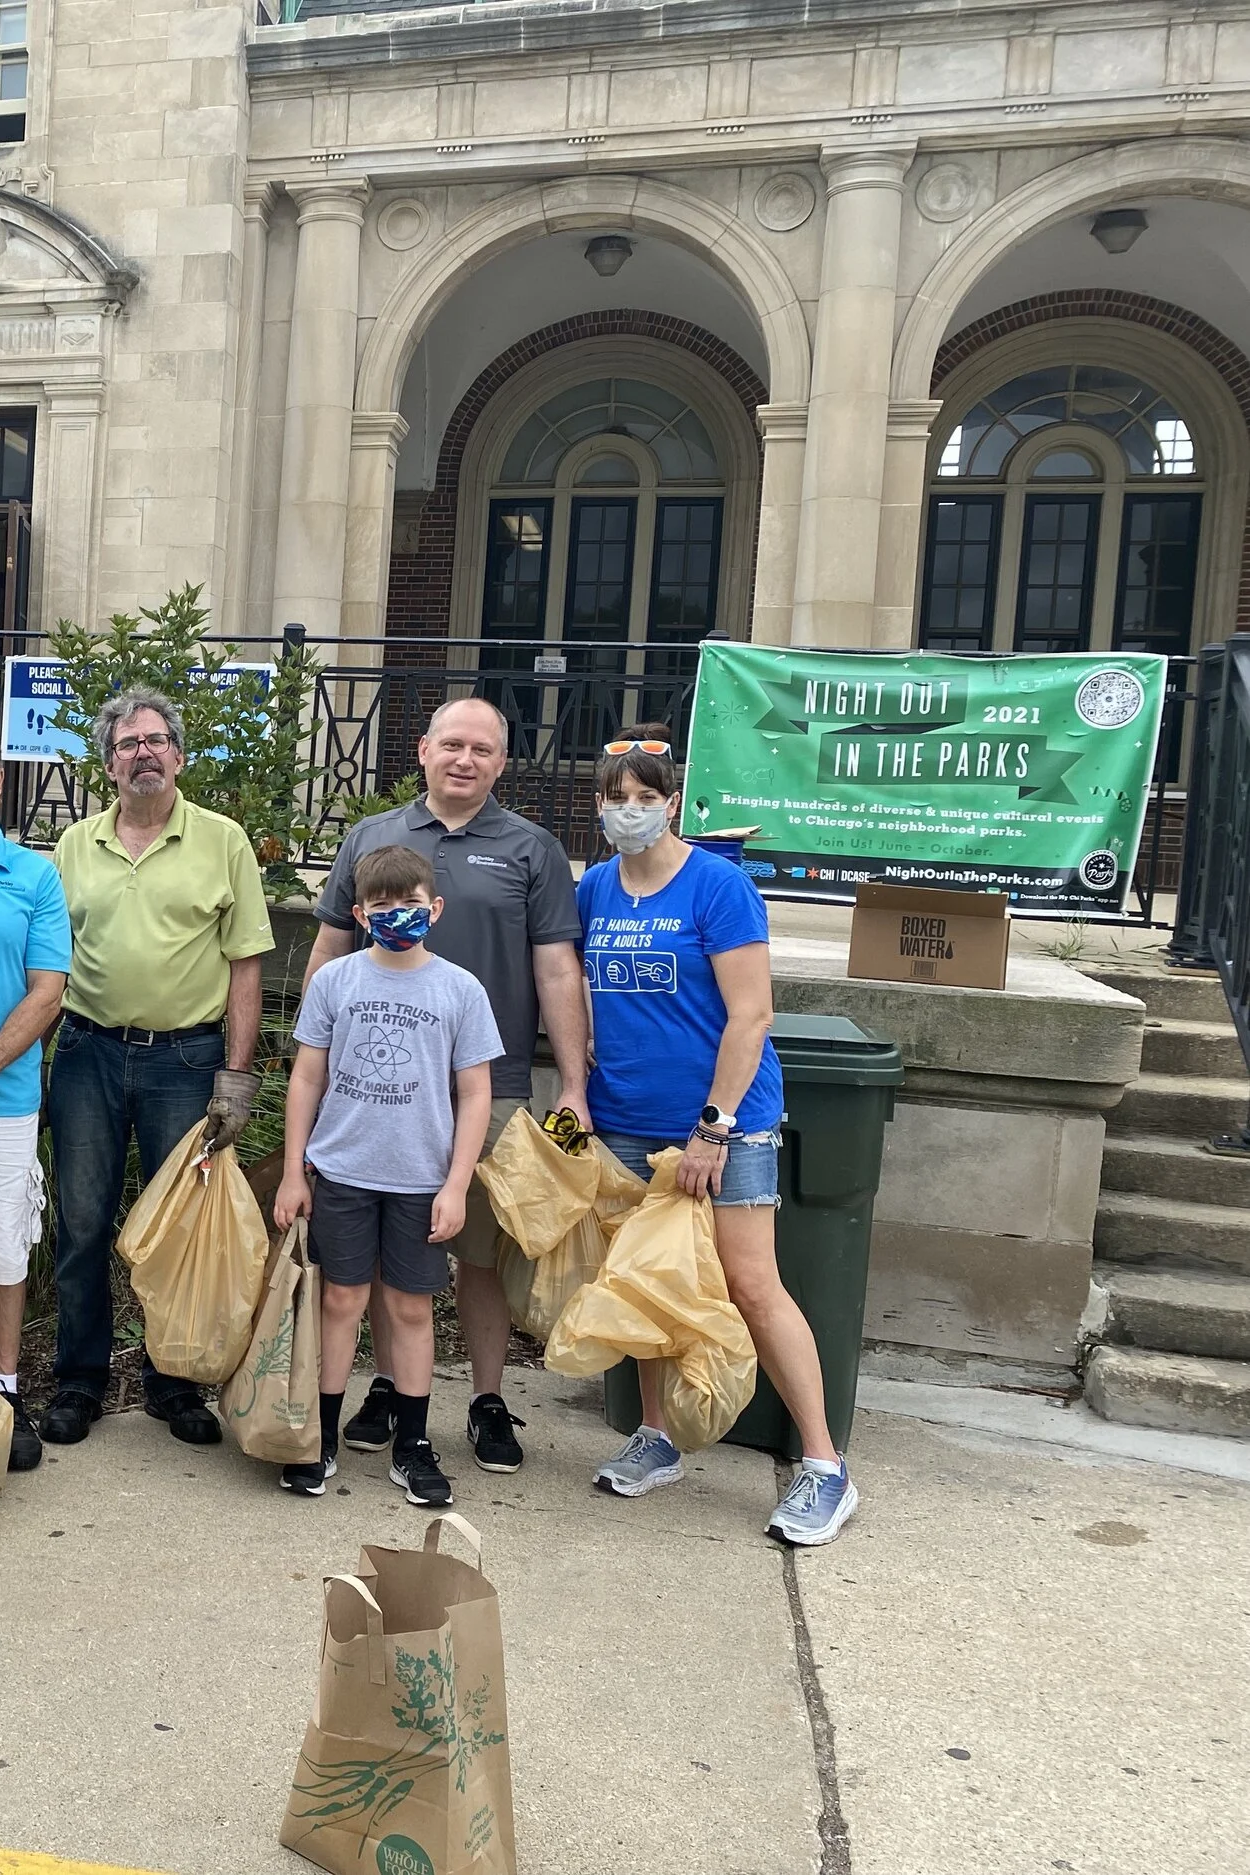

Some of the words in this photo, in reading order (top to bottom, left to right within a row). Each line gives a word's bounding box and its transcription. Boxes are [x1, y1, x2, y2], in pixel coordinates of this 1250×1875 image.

[31, 682, 63, 695] SOCIAL
[804, 680, 886, 715] NIGHT
[901, 681, 951, 715] OUT
[983, 706, 1040, 724] 2021
[834, 742, 861, 777] IN
[877, 742, 925, 777] THE
[938, 742, 1030, 778] PARKS
[722, 794, 781, 809] Bringing
[784, 798, 848, 812] hundreds
[851, 802, 865, 812] of
[869, 803, 921, 816] diverse
[925, 806, 936, 816] &
[940, 809, 989, 821] unique
[993, 810, 1052, 823] cultural
[1056, 813, 1105, 824] events
[788, 815, 801, 824] to
[805, 816, 874, 830] Chicago's
[878, 821, 976, 835] neighborhood
[979, 826, 1027, 838] parks.
[815, 836, 844, 848] Join
[850, 838, 873, 849] Us!
[878, 839, 912, 852] June
[930, 843, 993, 857] October.
[820, 868, 835, 881] CHI
[841, 870, 870, 883] DCASE
[885, 866, 1064, 888] NightOutInTheParks.com
[606, 918, 650, 932] HANDLE
[651, 917, 682, 932] THIS
[901, 915, 947, 938] BOXED
[589, 934, 612, 947] LIKE
[612, 934, 654, 948] ADULTS
[899, 936, 944, 960] WATER
[348, 1001, 390, 1017] NEVER
[395, 1003, 440, 1027] TRUST
[360, 1012, 378, 1024] AN
[382, 1013, 419, 1031] ATOM
[335, 1070, 362, 1089] THEY
[364, 1080, 400, 1094] MAKE
[403, 1081, 419, 1093] UP
[334, 1083, 412, 1105] EVERYTHING
[382, 1846, 430, 1875] WHOLE
